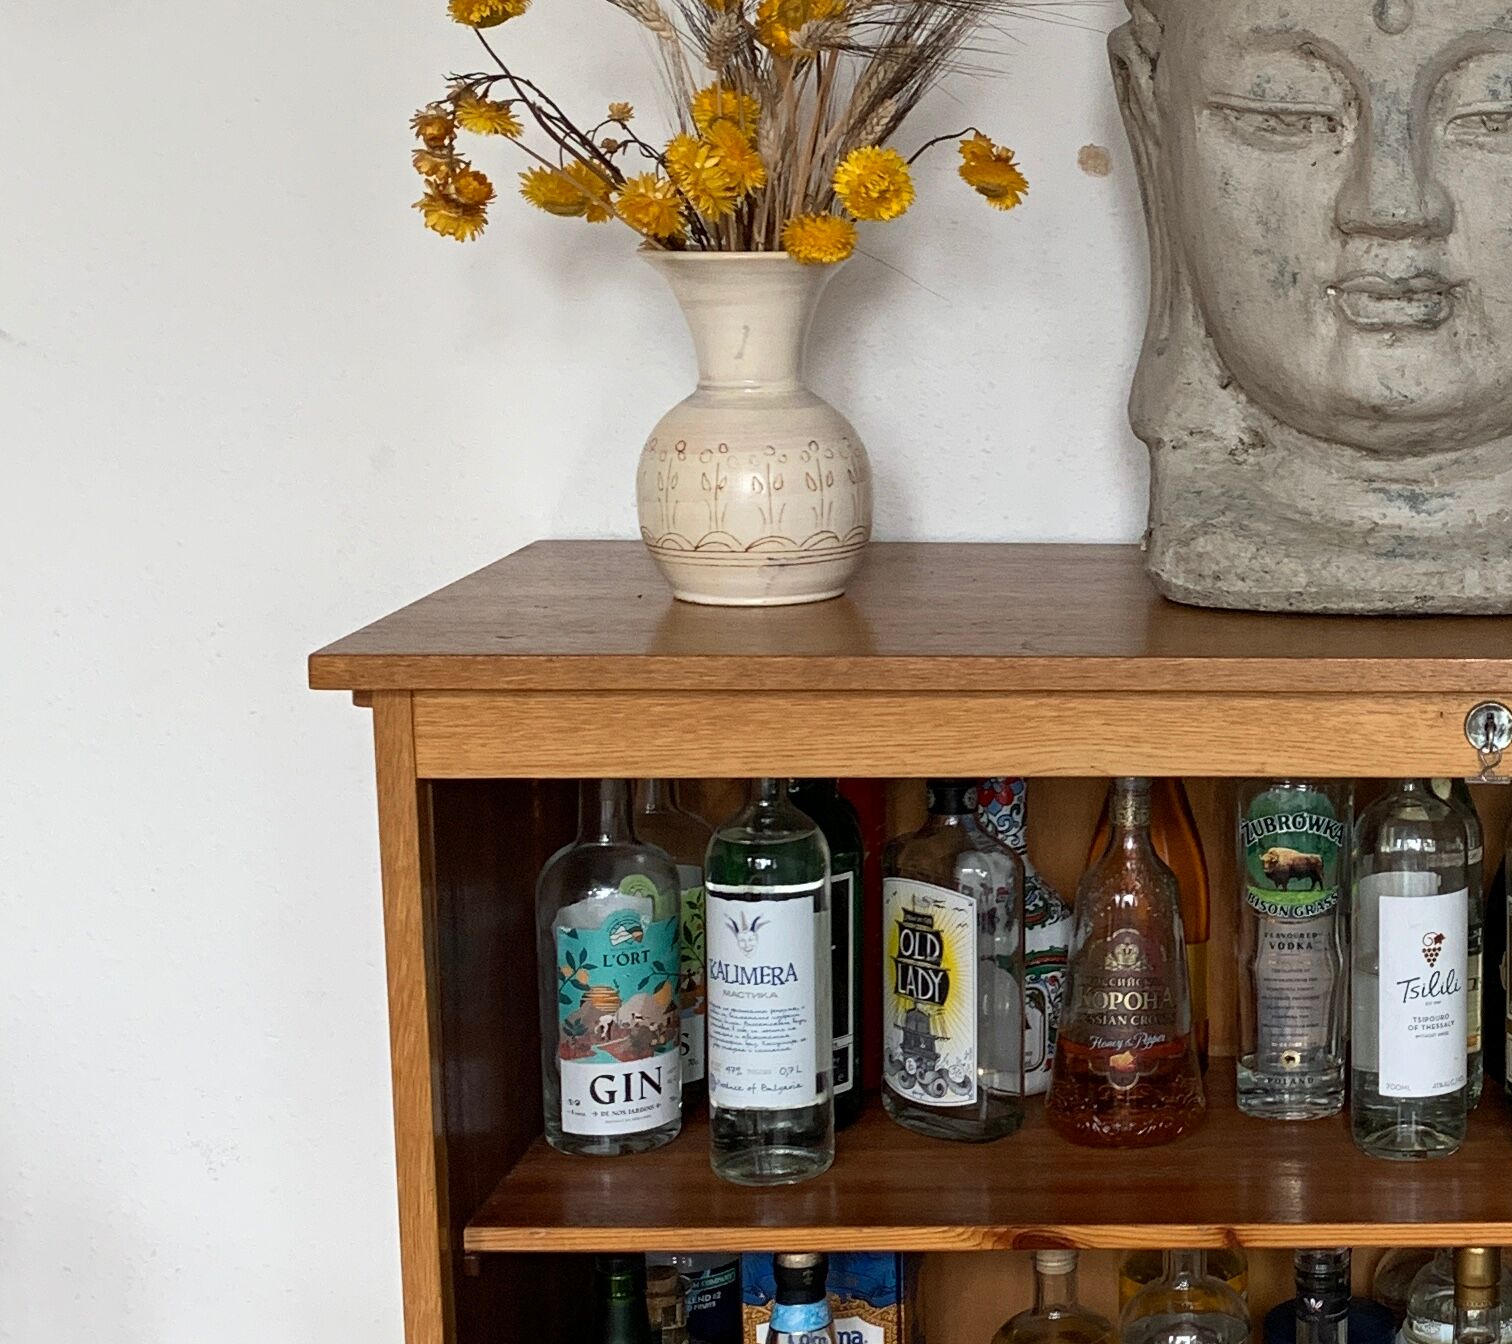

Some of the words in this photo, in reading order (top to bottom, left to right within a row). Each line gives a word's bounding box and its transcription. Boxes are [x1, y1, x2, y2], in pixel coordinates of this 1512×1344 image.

[1247, 892, 1289, 917] BISON
[1293, 892, 1339, 918] GRASS
[900, 928, 940, 961] OLD
[1269, 942, 1313, 950] VODKA
[709, 959, 798, 986] KALIMERA
[897, 961, 944, 1003] LADY
[1396, 968, 1461, 1003] Tsilili
[1084, 1015, 1128, 1025] SSIAN
[1413, 1013, 1450, 1023] TSIPOURO
[1422, 1020, 1455, 1031] THESSALY
[589, 1066, 662, 1105] GIN
[1267, 1077, 1314, 1085] POLAND
